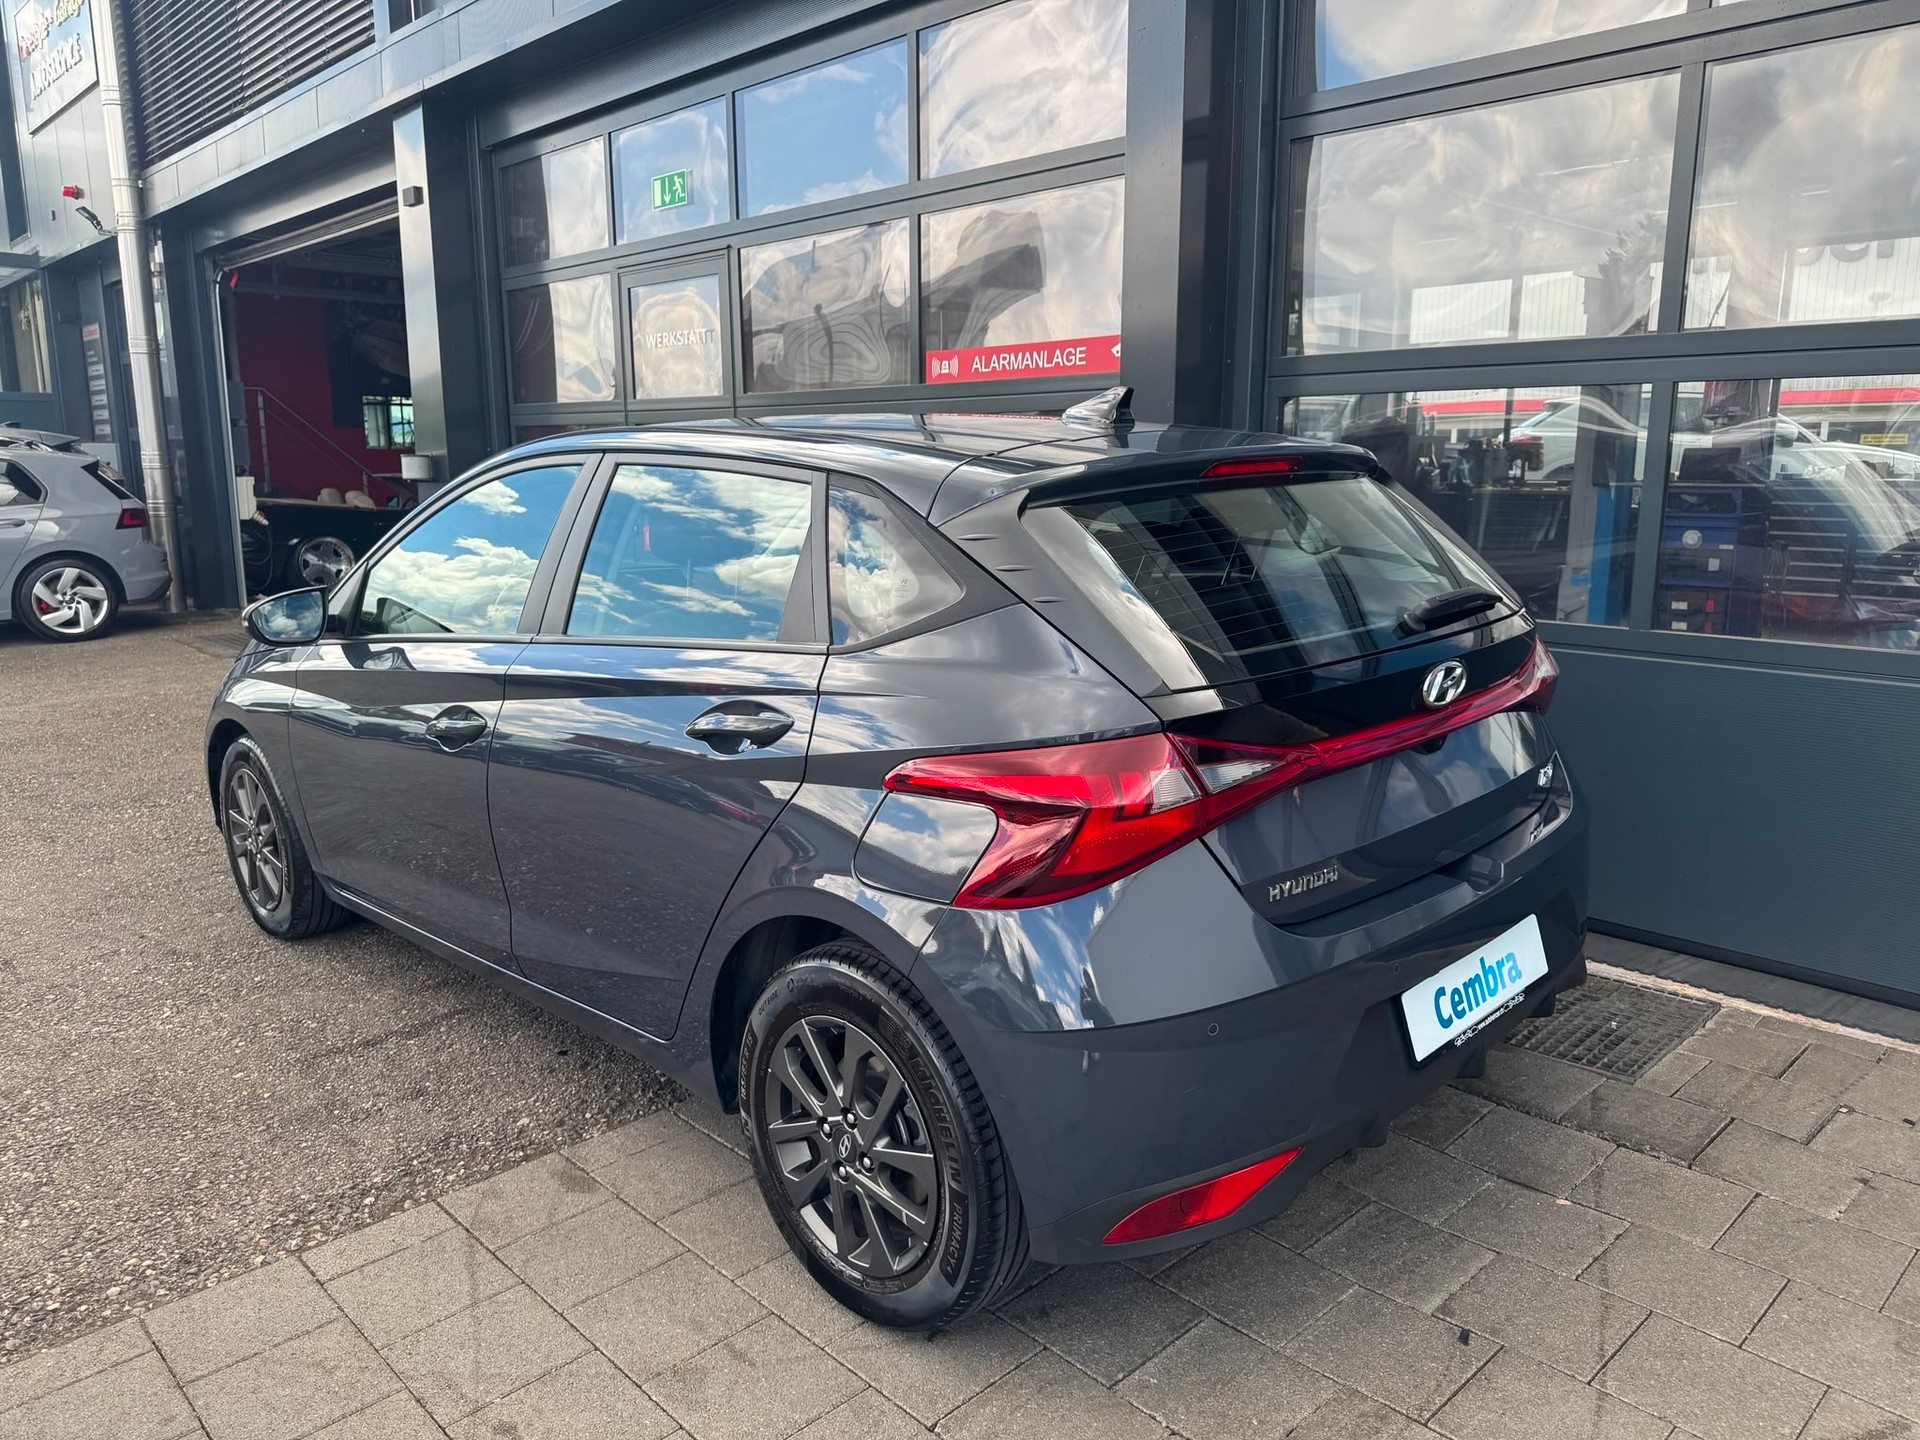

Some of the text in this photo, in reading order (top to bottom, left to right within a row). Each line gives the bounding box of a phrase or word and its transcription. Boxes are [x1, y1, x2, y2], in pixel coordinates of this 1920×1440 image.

[645, 328, 707, 349] WERKSTATT
[971, 347, 1087, 373] ALARMANLAGE
[1268, 865, 1338, 902] HYUNDAI
[758, 989, 779, 1016] OUTSIDE
[1433, 951, 1523, 1030] Cembra
[910, 1056, 964, 1186] MICHELIN
[947, 1202, 962, 1268] PRIMACY
